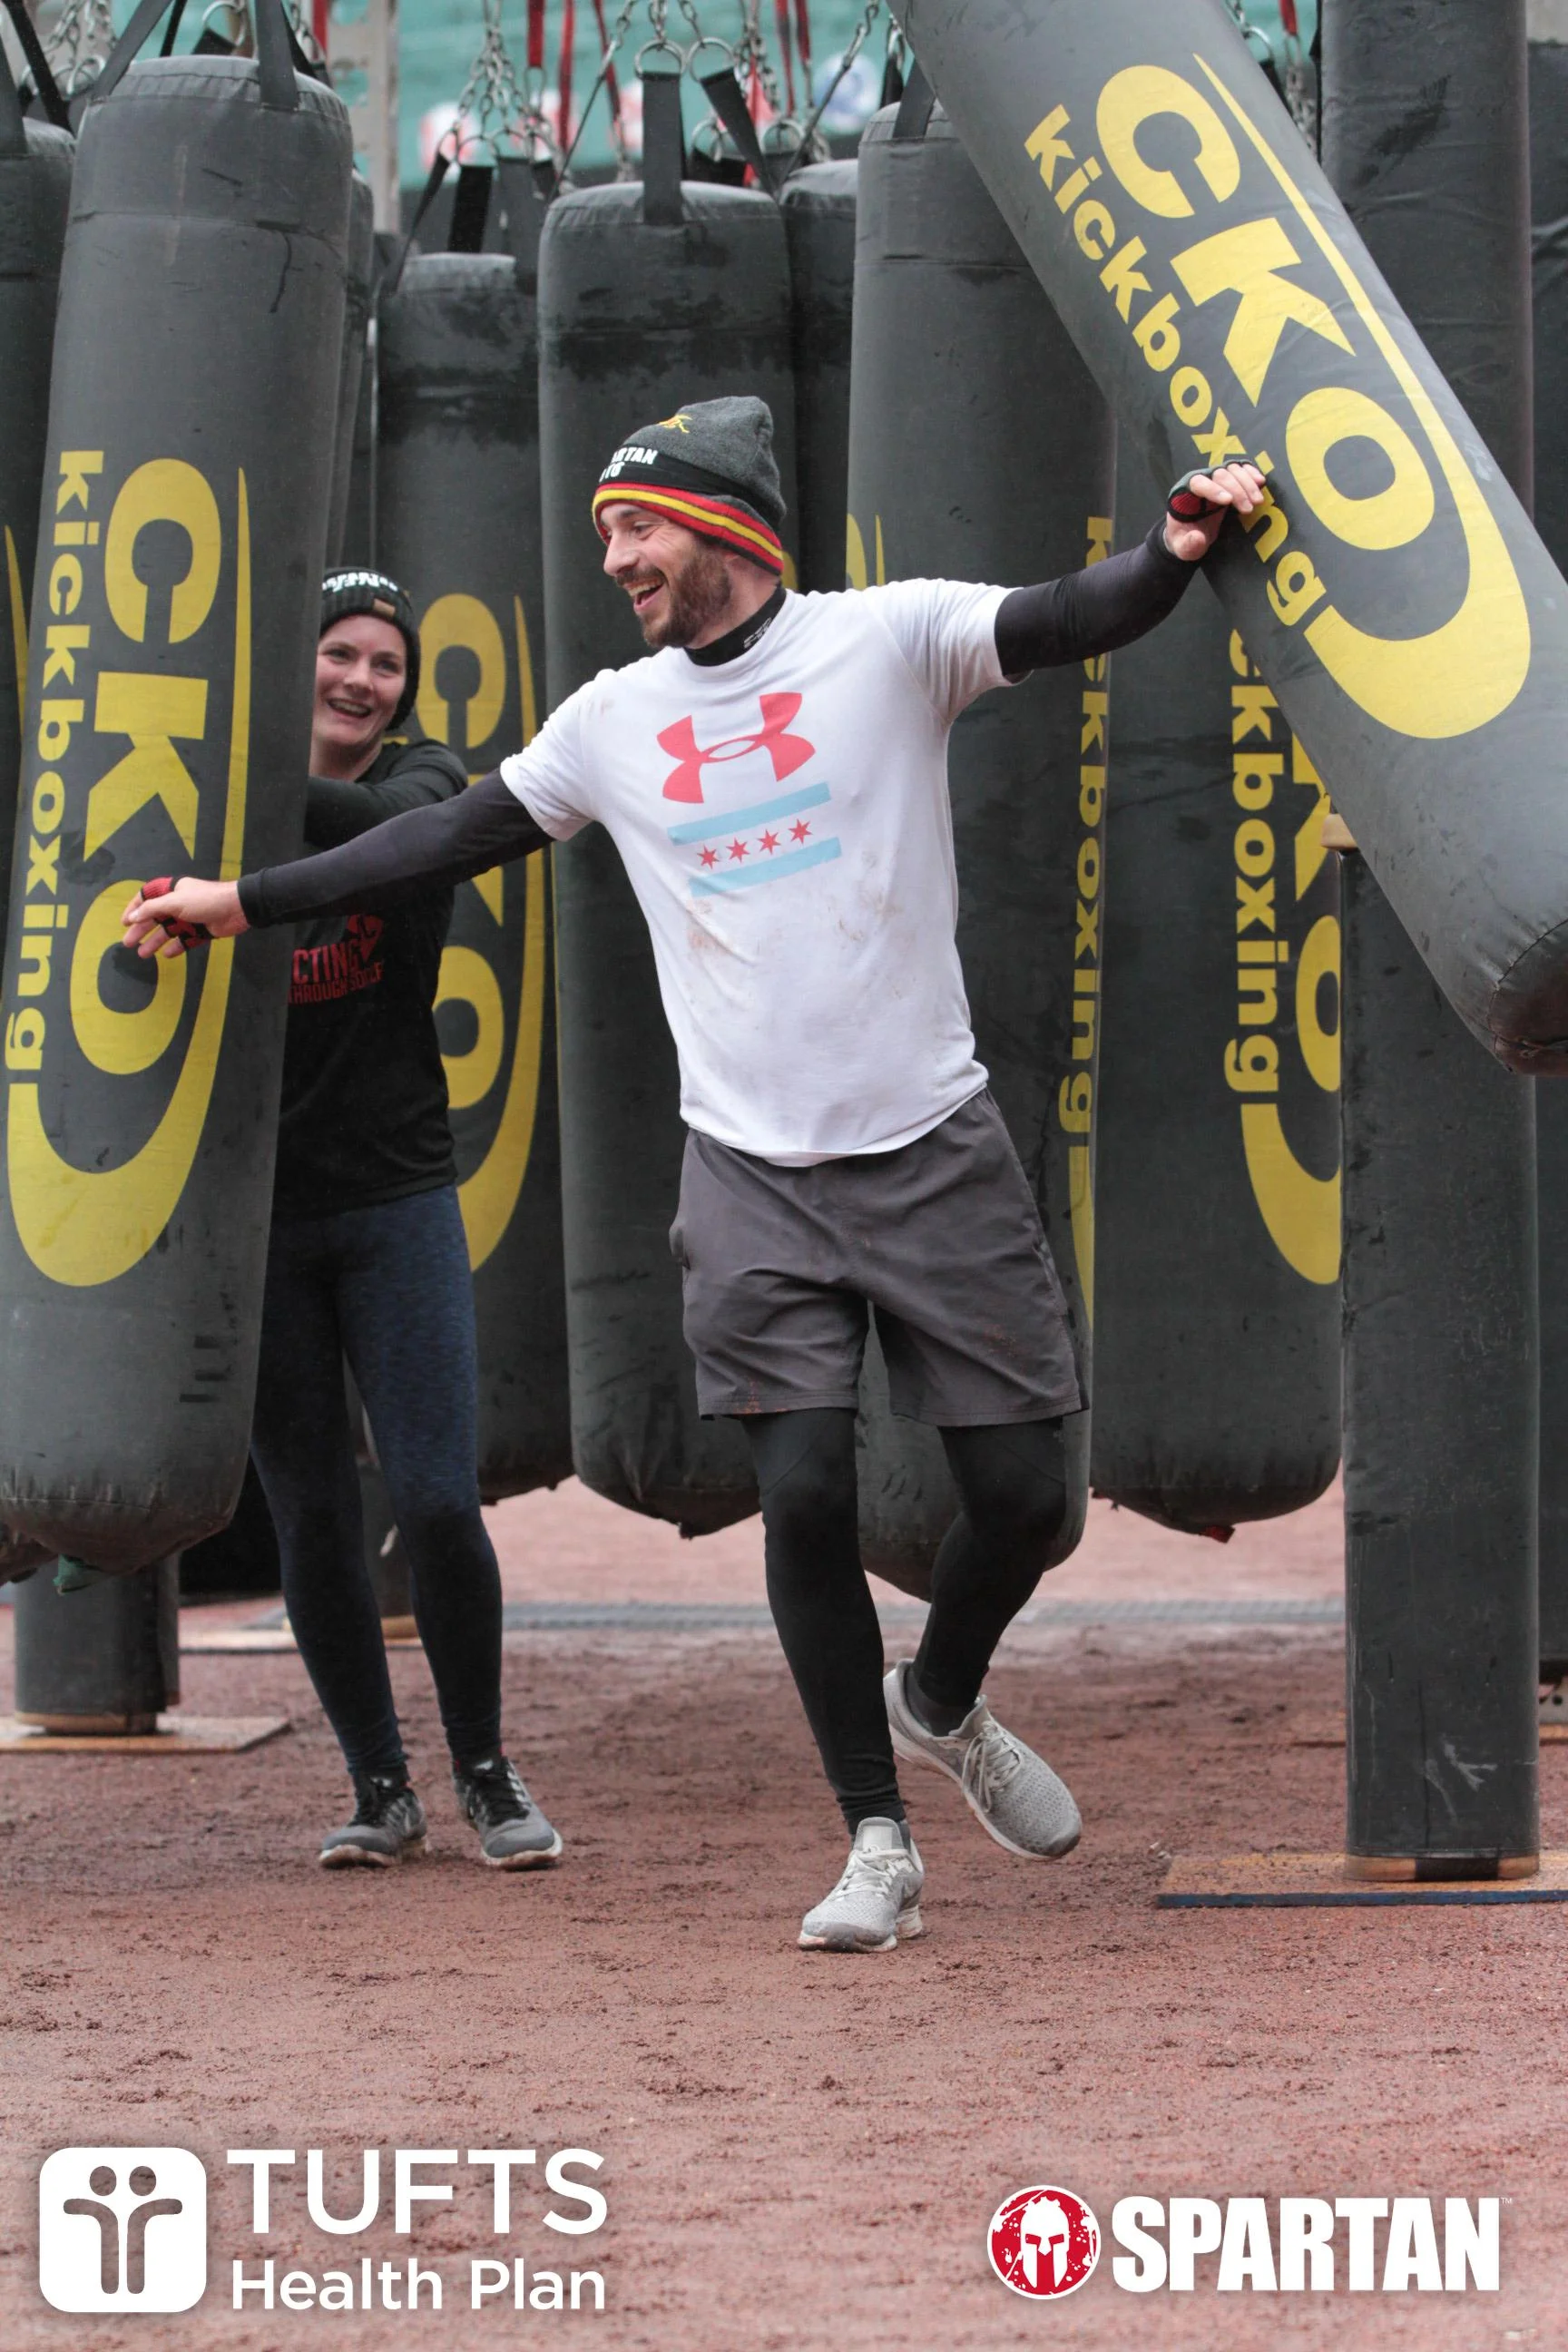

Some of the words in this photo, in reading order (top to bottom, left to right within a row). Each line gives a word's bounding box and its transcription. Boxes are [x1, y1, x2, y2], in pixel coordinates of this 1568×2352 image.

[1095, 64, 1436, 551] CKO
[5, 449, 104, 1072] kickboxing
[70, 457, 222, 1075] CKO
[1058, 516, 1112, 1133] kckboxing
